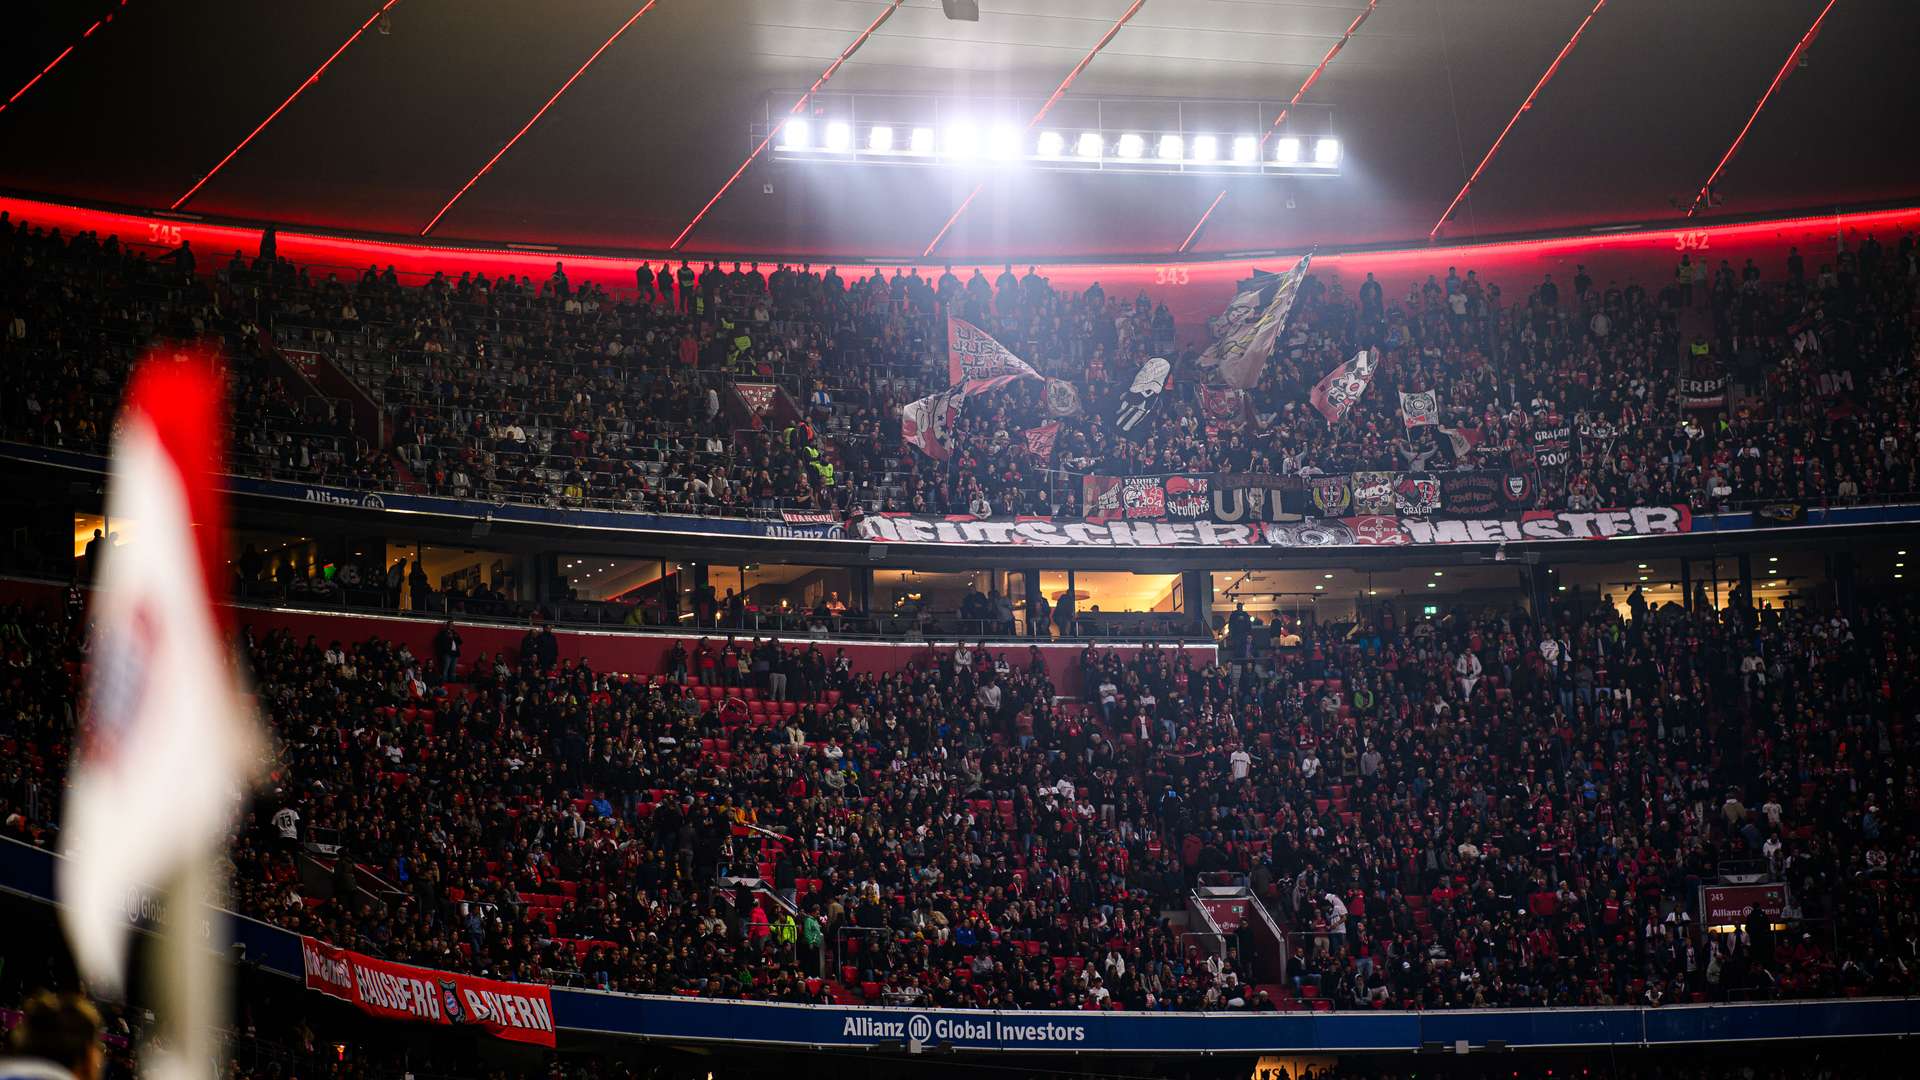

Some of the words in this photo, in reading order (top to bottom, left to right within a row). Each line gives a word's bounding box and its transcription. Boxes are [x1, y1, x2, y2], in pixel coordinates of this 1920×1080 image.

[149, 224, 182, 244] 345
[1674, 231, 1710, 250] 342
[1154, 266, 1189, 285] 343
[306, 489, 359, 507] Allianz
[1167, 501, 1209, 519] Brothers
[1403, 505, 1432, 516] GRAFEN
[765, 525, 824, 540] Allianz
[1402, 506, 1680, 543] MEISTER
[1712, 908, 1741, 918] Allianz
[353, 963, 441, 1021] HAUSBERG
[463, 988, 553, 1032] BAYERN
[843, 1016, 905, 1037] Allianz
[935, 1019, 992, 1041] Global
[996, 1021, 1085, 1041] Investors
